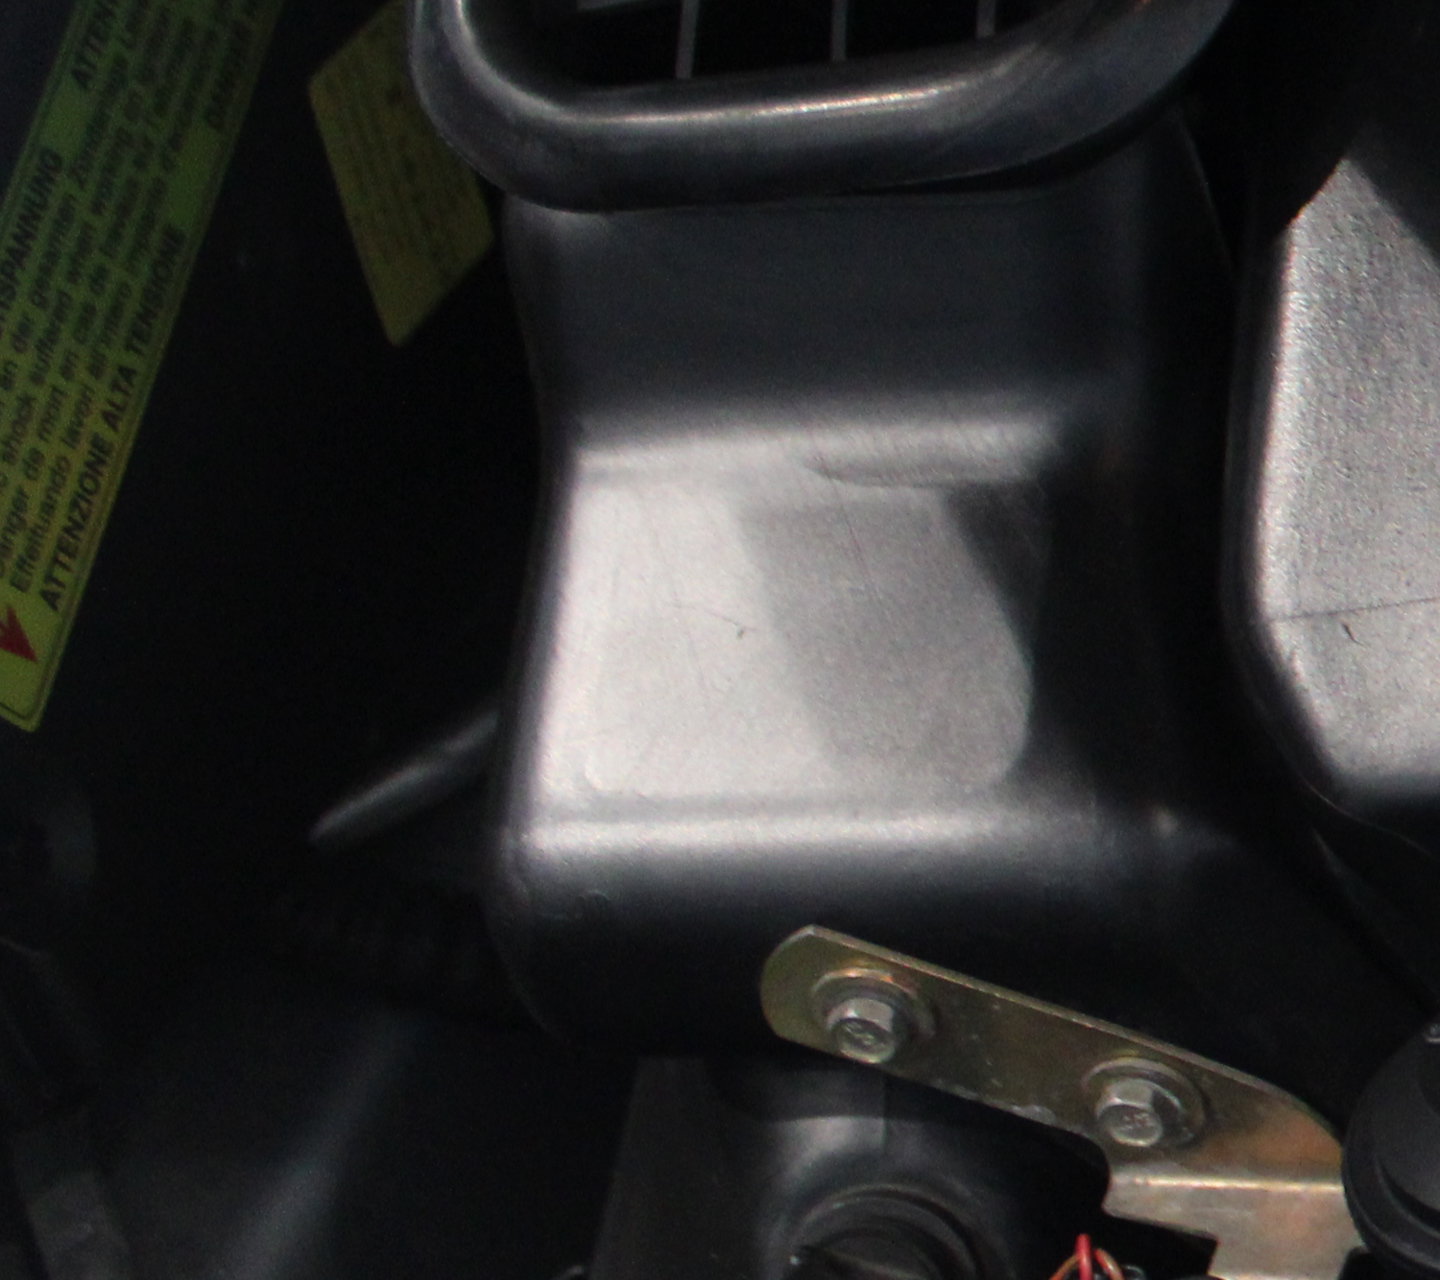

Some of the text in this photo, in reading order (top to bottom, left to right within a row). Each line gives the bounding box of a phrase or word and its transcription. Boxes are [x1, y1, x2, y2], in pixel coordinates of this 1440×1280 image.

[39, 220, 185, 610] ATTENZIONE ALTA TENSIONE
